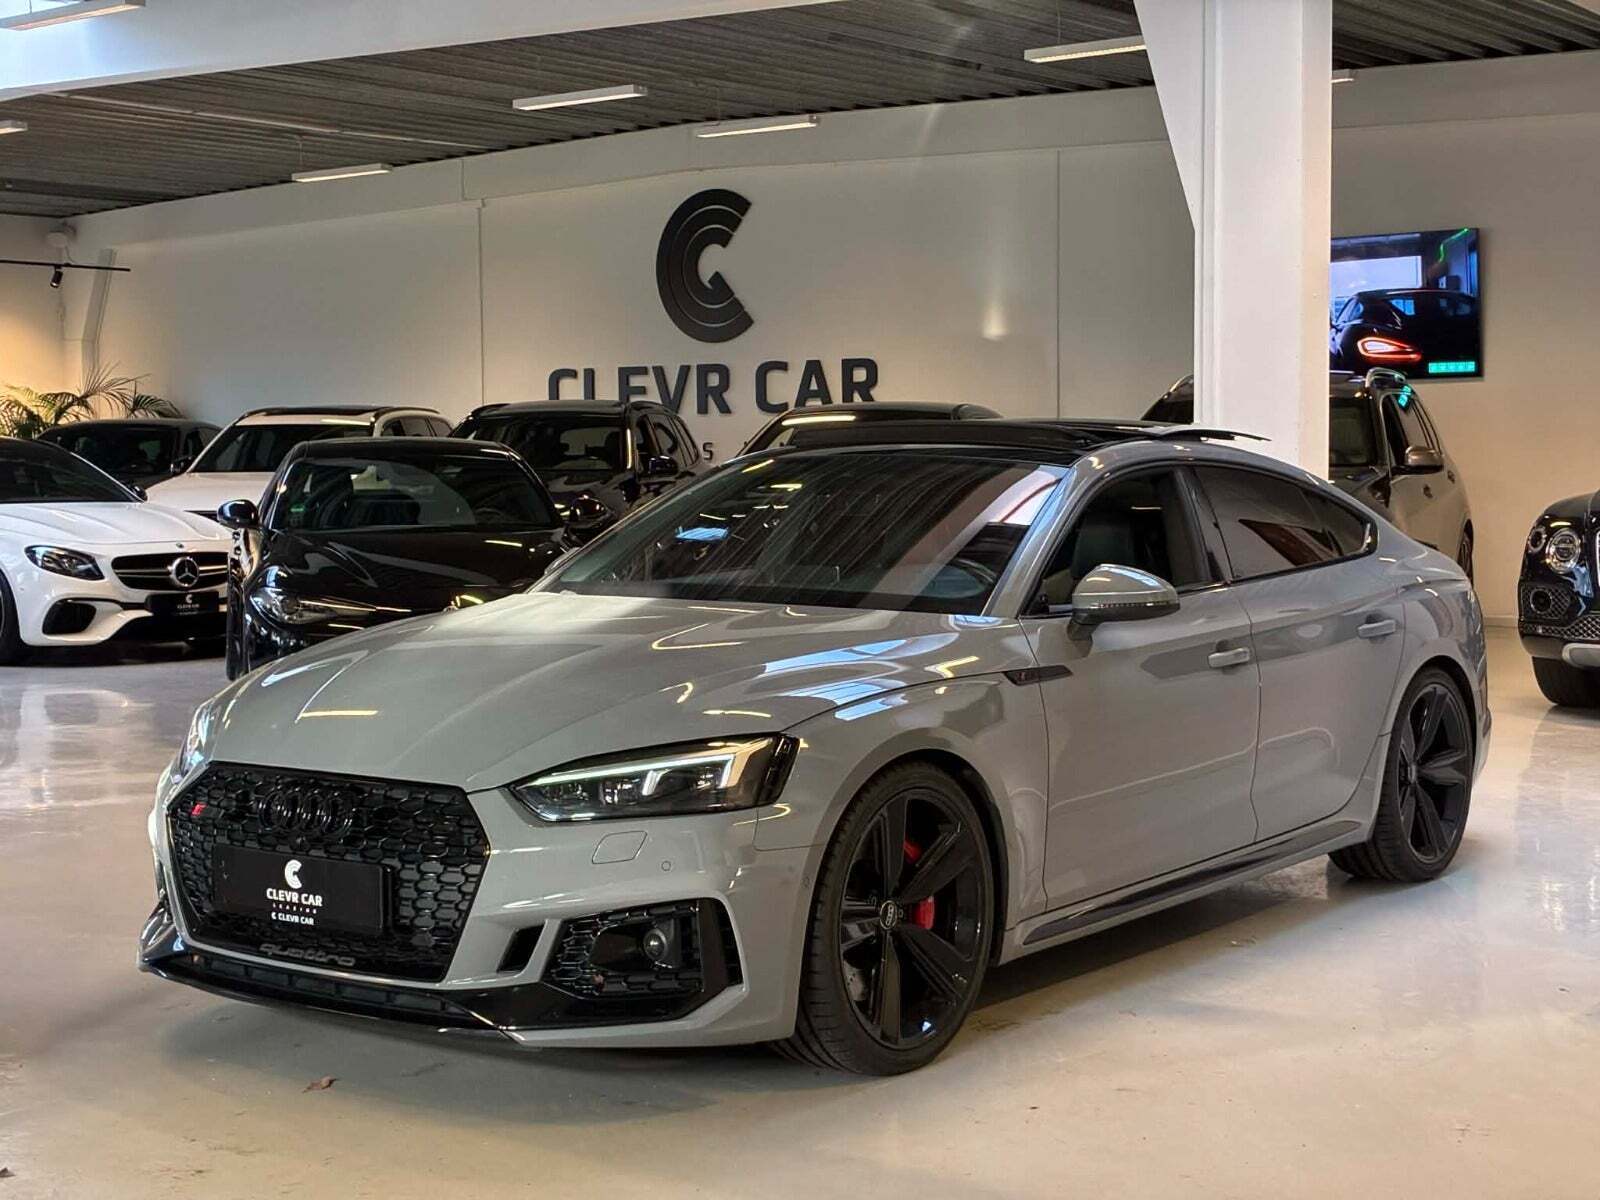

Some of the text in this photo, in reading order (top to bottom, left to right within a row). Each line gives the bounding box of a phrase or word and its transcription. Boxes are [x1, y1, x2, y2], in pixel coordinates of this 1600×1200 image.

[755, 358, 879, 413] CAR
[266, 888, 323, 907] CLEVR CAR
[278, 912, 300, 923] CLEVR
[300, 916, 315, 926] CAR
[260, 943, 356, 966] quattro
